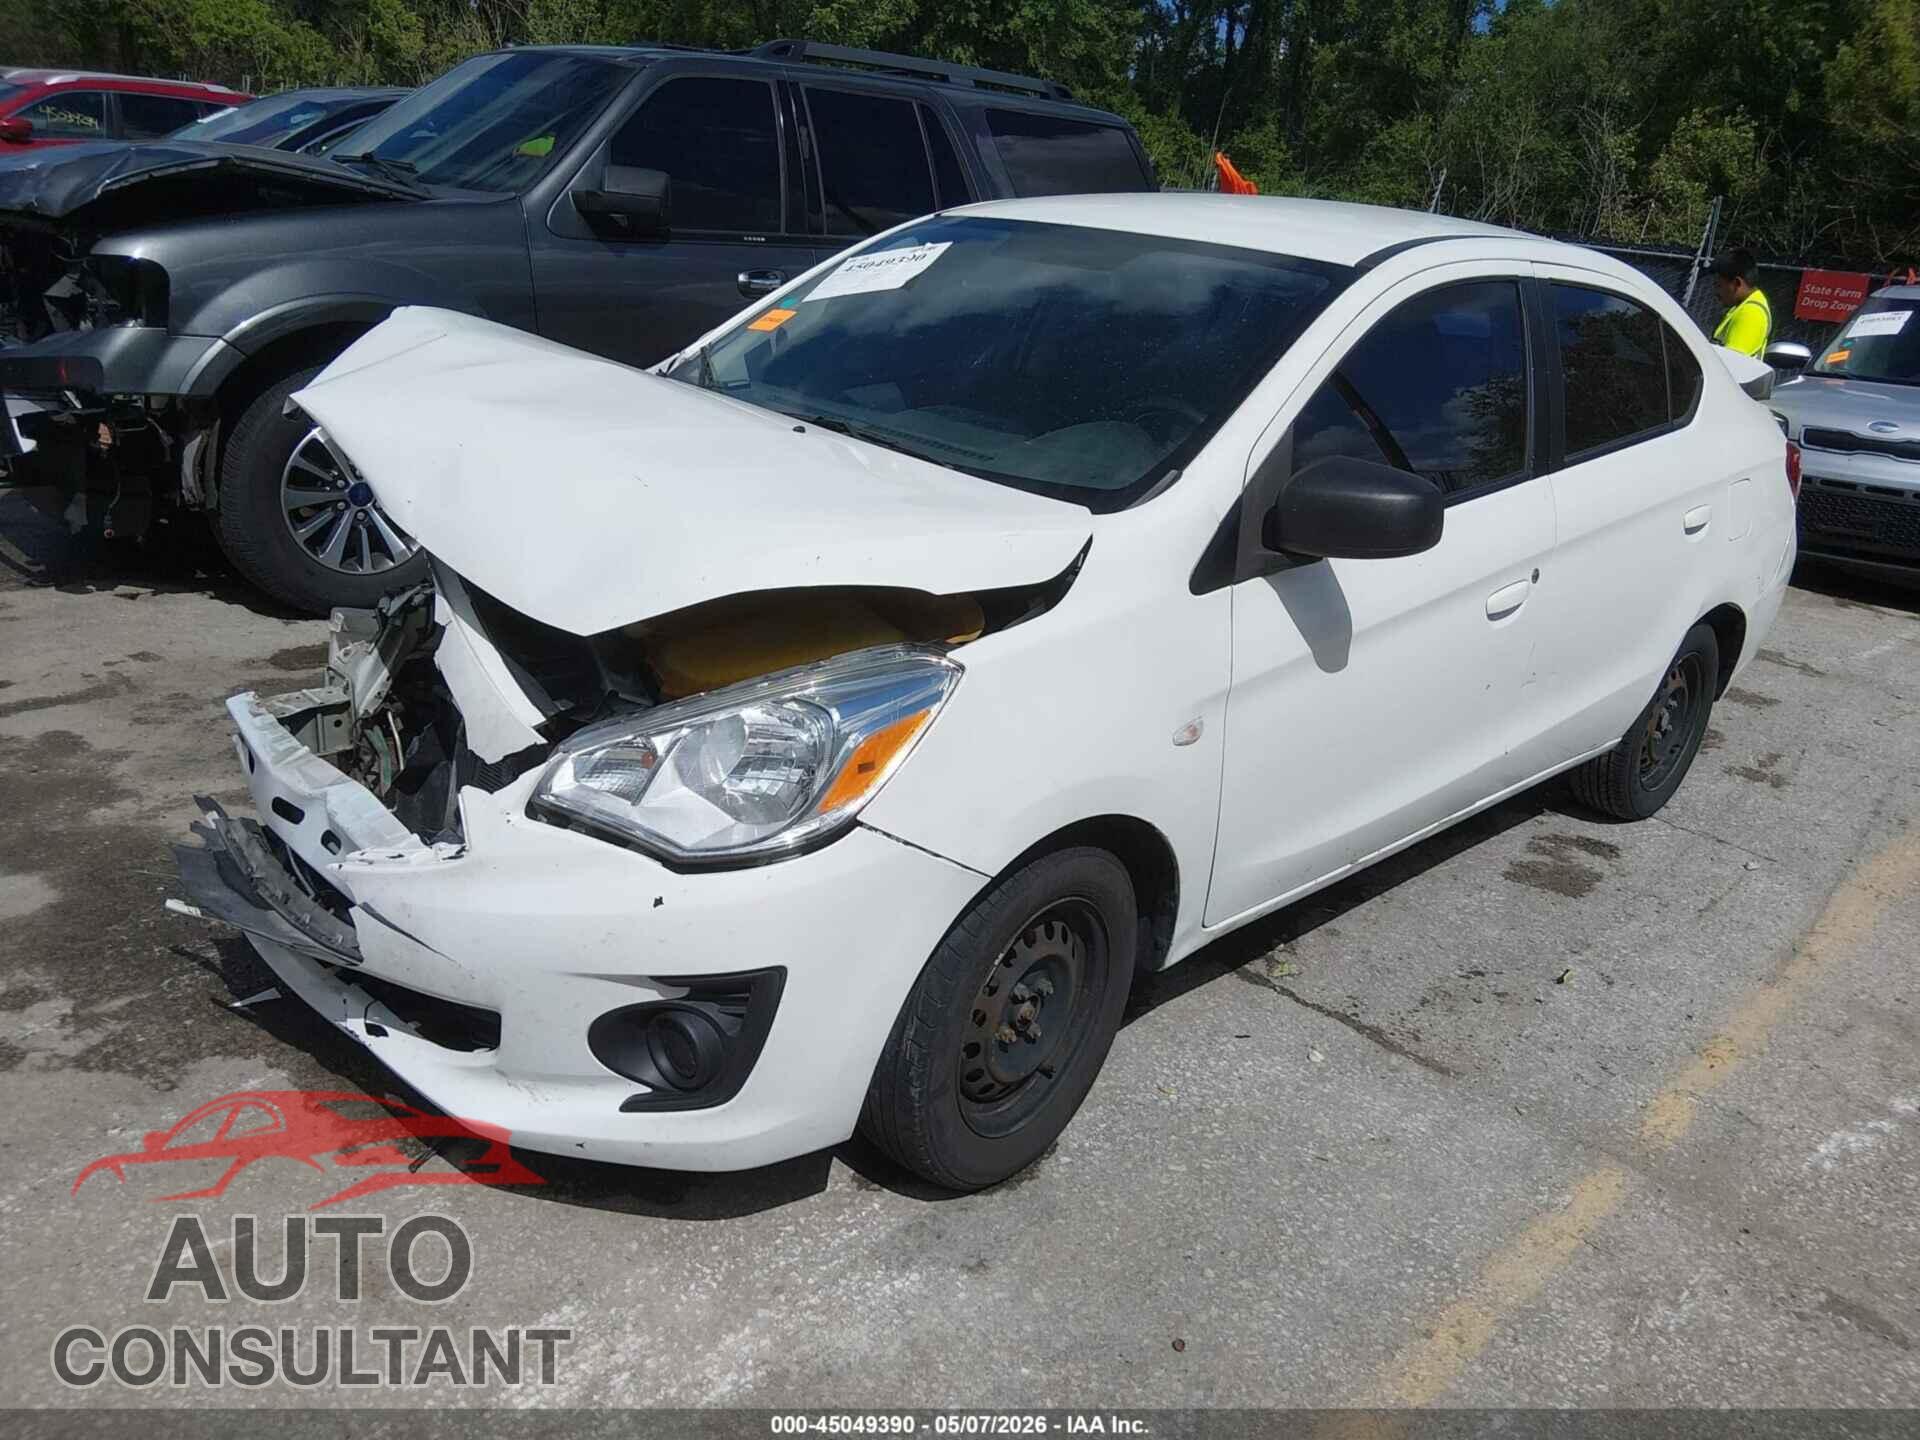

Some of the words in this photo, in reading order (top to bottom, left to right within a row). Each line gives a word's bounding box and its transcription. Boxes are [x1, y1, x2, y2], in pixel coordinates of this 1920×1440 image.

[1803, 283, 1832, 296] State
[1833, 288, 1862, 299] Farm
[1801, 296, 1829, 309] Drop
[1829, 300, 1858, 312] Zone
